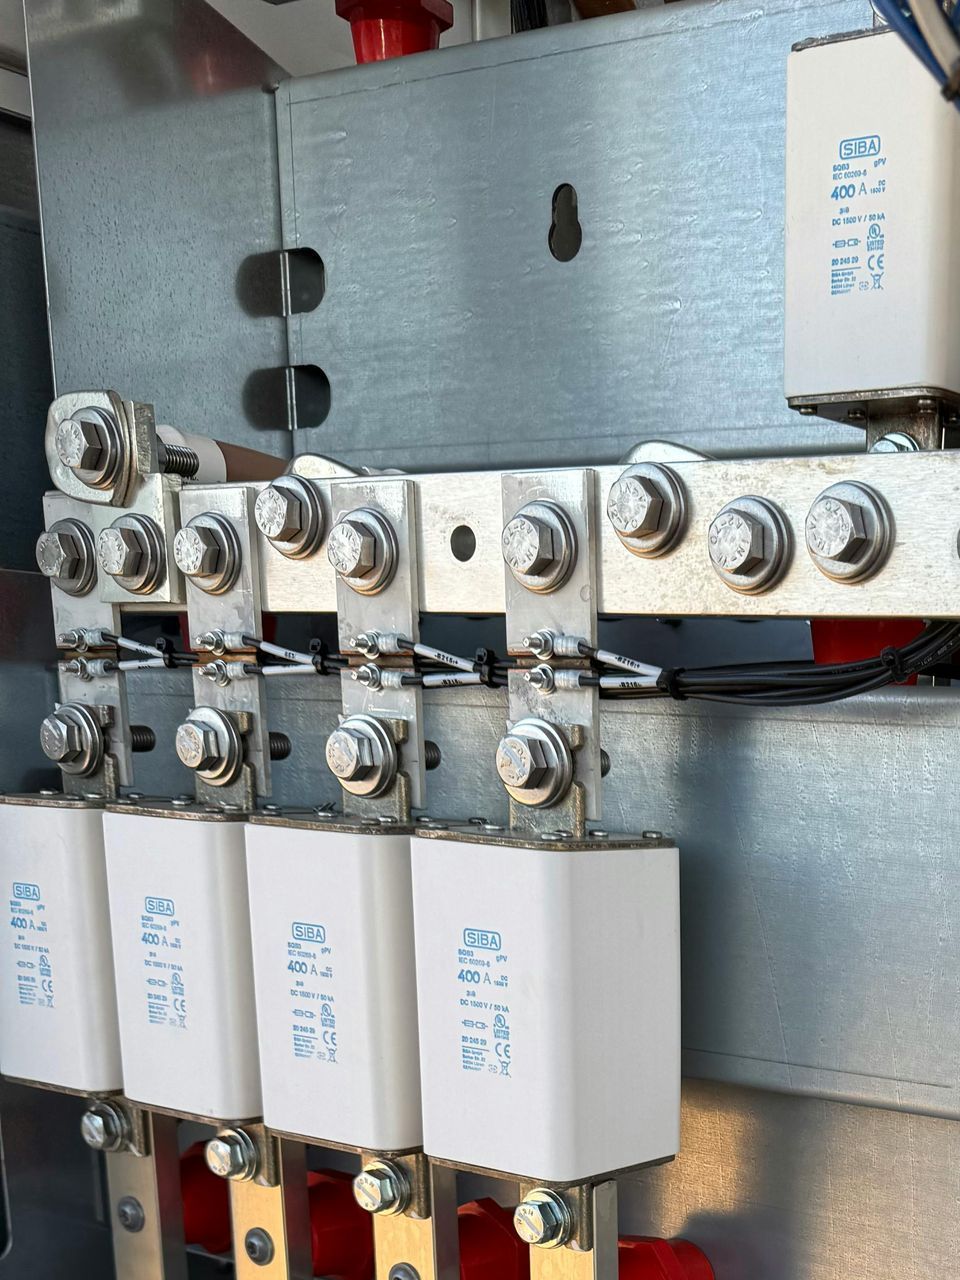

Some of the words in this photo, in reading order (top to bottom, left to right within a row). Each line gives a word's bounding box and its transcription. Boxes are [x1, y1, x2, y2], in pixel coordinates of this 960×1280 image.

[843, 139, 877, 156] SIBA
[831, 184, 856, 201] 400
[859, 182, 867, 195] A
[832, 218, 841, 226] DC
[15, 886, 38, 898] SIBA
[148, 900, 173, 914] SIBA
[10, 916, 27, 929] 400
[29, 920, 36, 930] A
[141, 932, 160, 945] 400
[162, 936, 168, 947] A
[295, 925, 323, 940] SIBA
[467, 932, 498, 948] SIBA
[287, 960, 308, 974] 400
[310, 964, 318, 976] A
[457, 969, 481, 984] 400
[483, 972, 491, 985] A
